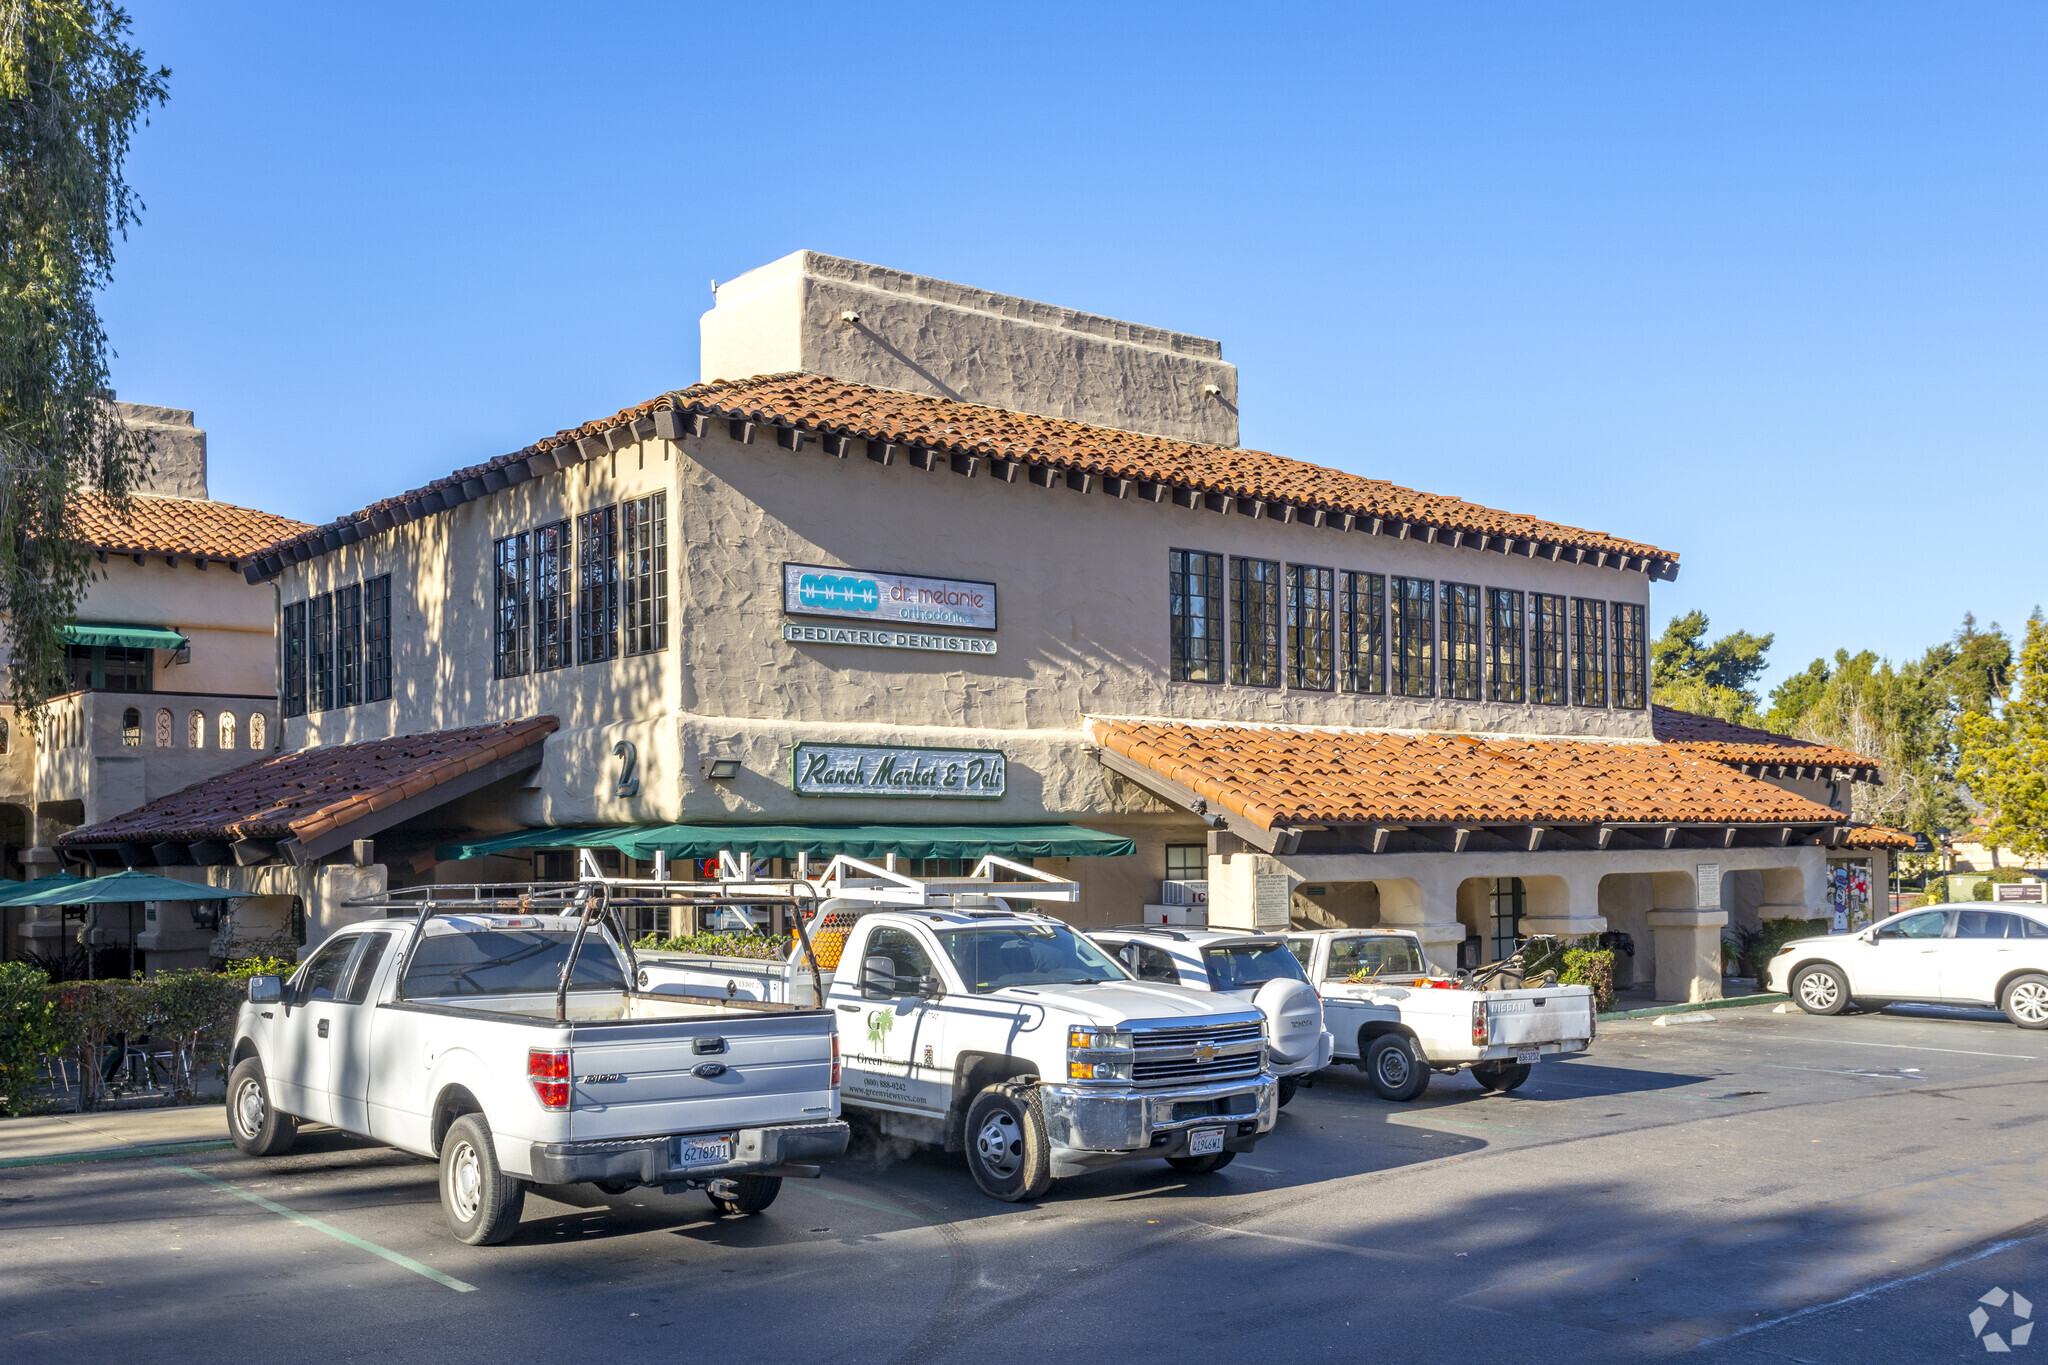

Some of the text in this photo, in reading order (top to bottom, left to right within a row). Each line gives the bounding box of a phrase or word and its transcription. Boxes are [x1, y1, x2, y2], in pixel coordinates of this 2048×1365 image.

[890, 580, 984, 608] dr. melanie
[900, 606, 975, 624] orthodontics
[791, 627, 991, 652] PEDIATRIC DENTISTRY
[612, 740, 640, 797] 2
[800, 753, 1001, 787] Ranch Market & Deli
[1192, 893, 1207, 903] IC
[1491, 1003, 1526, 1013] NISSAN
[857, 1053, 882, 1066] Green
[700, 1065, 721, 1075] Ford
[684, 1144, 728, 1161] 62789T1
